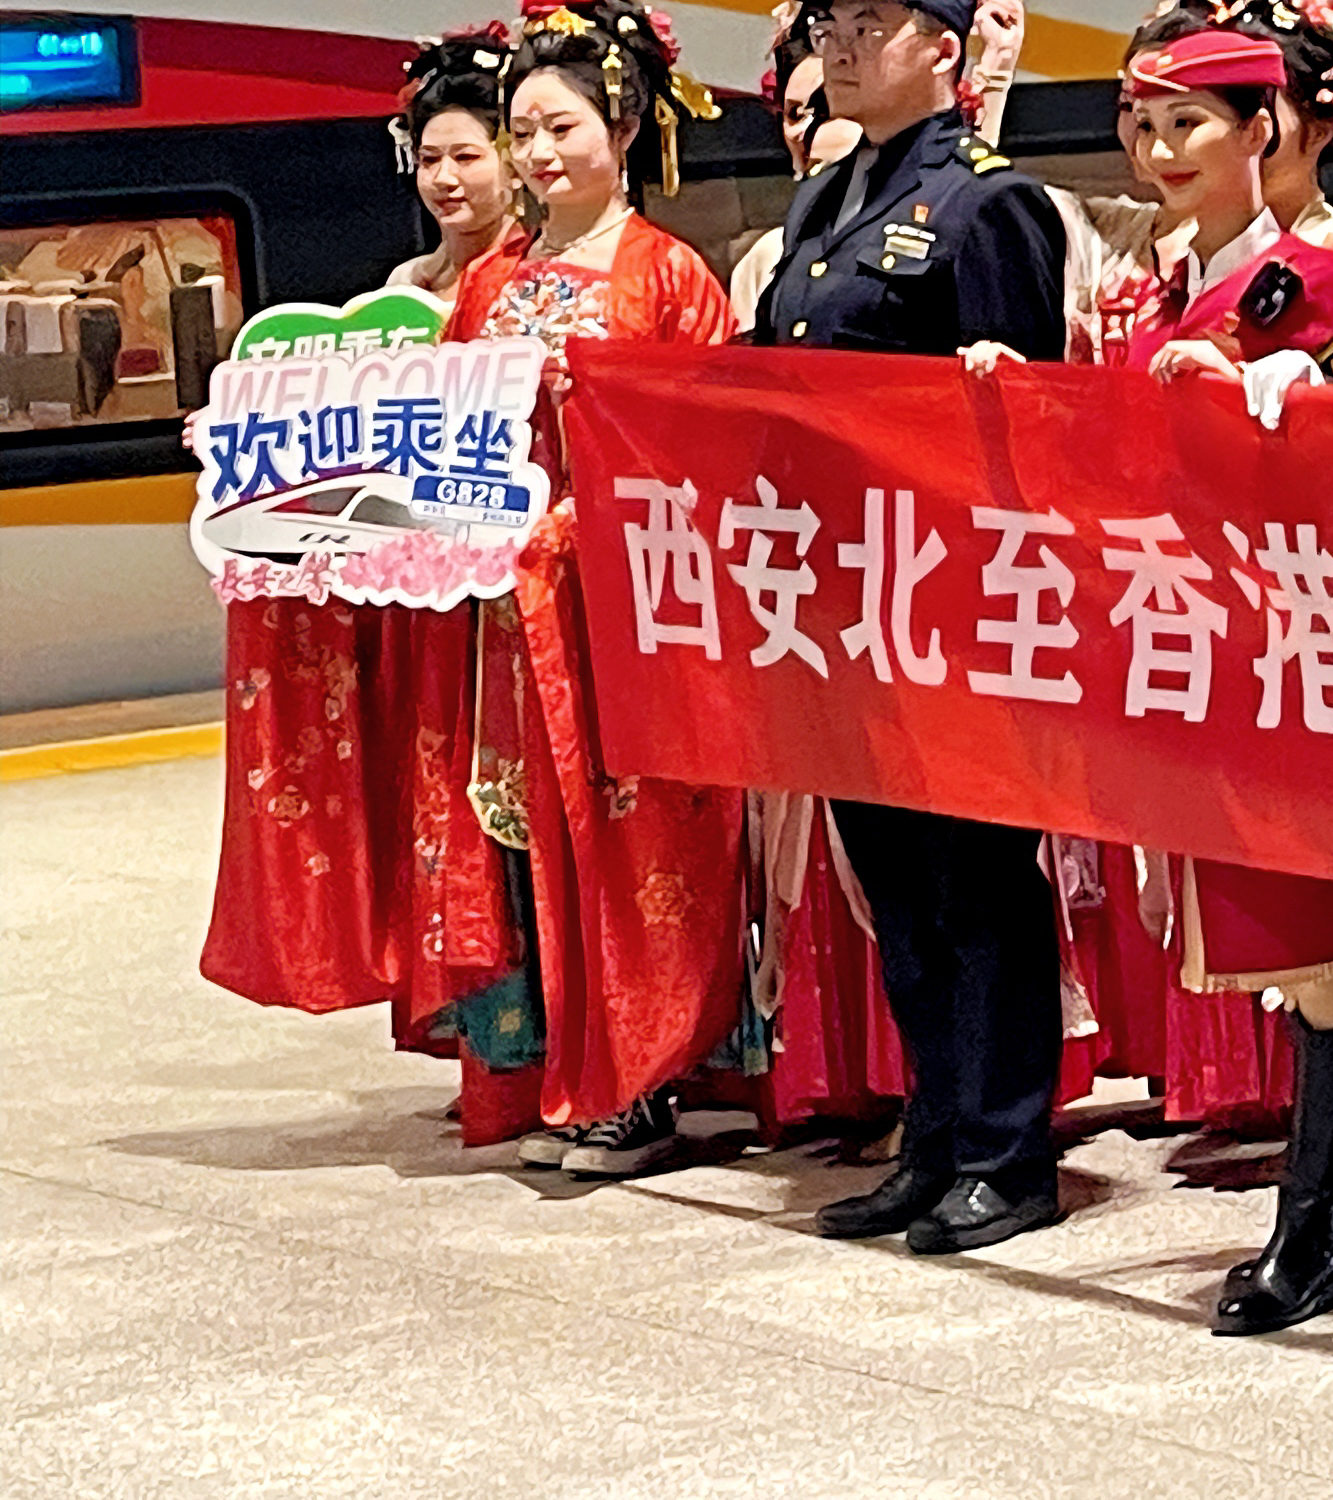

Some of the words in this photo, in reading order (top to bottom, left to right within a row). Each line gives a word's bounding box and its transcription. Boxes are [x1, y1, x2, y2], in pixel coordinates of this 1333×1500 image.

[208, 397, 514, 505] 欢迎乘坐
[436, 479, 507, 510] G828
